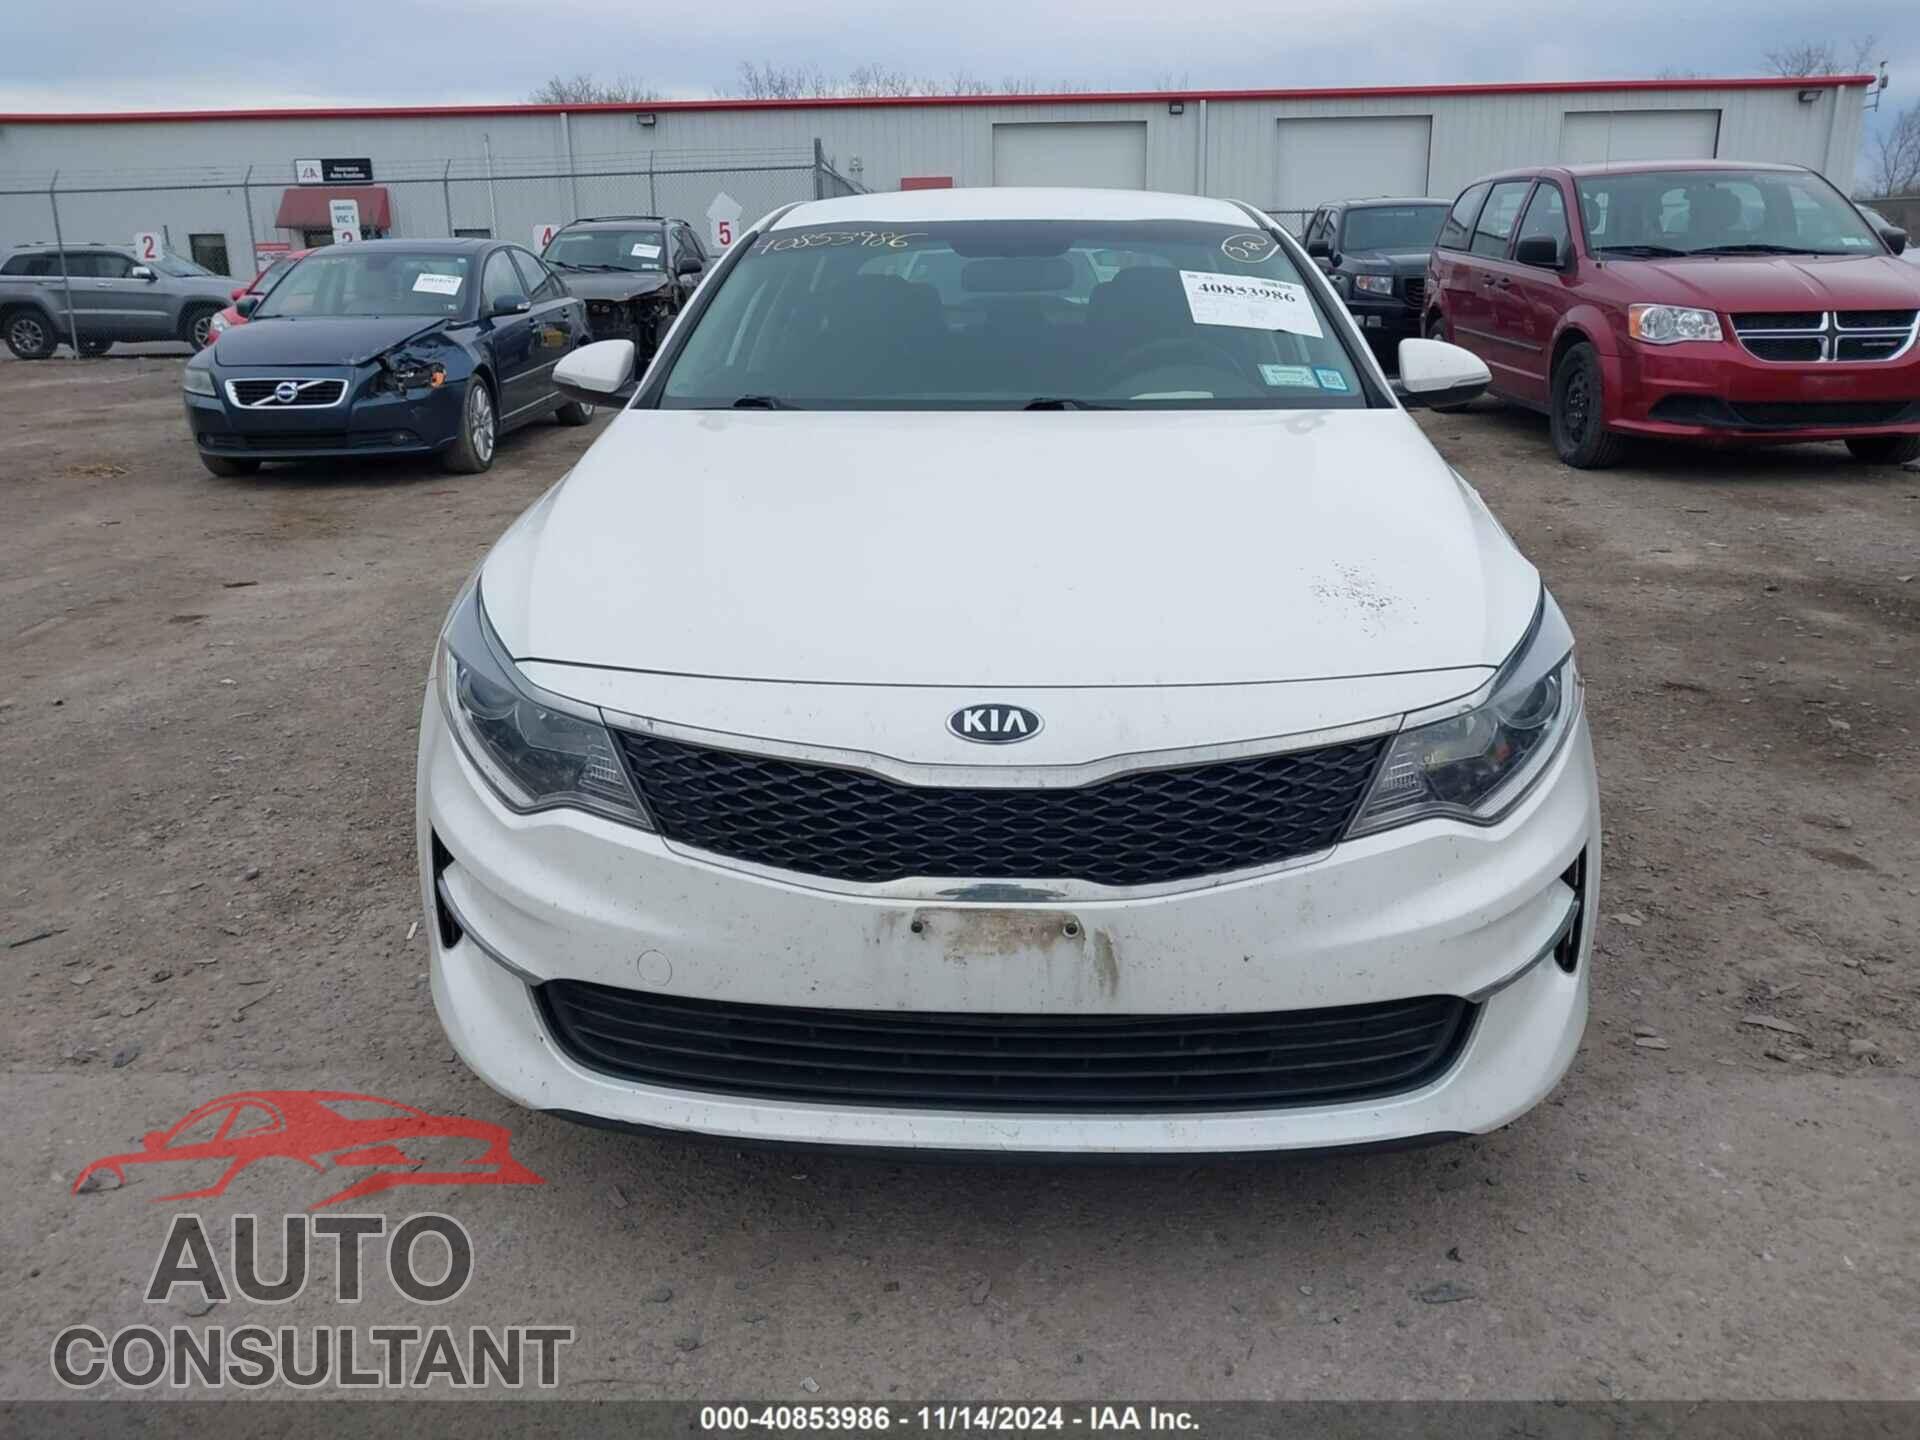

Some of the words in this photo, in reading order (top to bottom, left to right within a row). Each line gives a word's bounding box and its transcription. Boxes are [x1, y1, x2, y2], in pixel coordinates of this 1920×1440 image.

[718, 221, 732, 245] 5
[143, 235, 156, 259] 2
[1199, 283, 1296, 303] 40853986
[963, 709, 1028, 732] KIA
